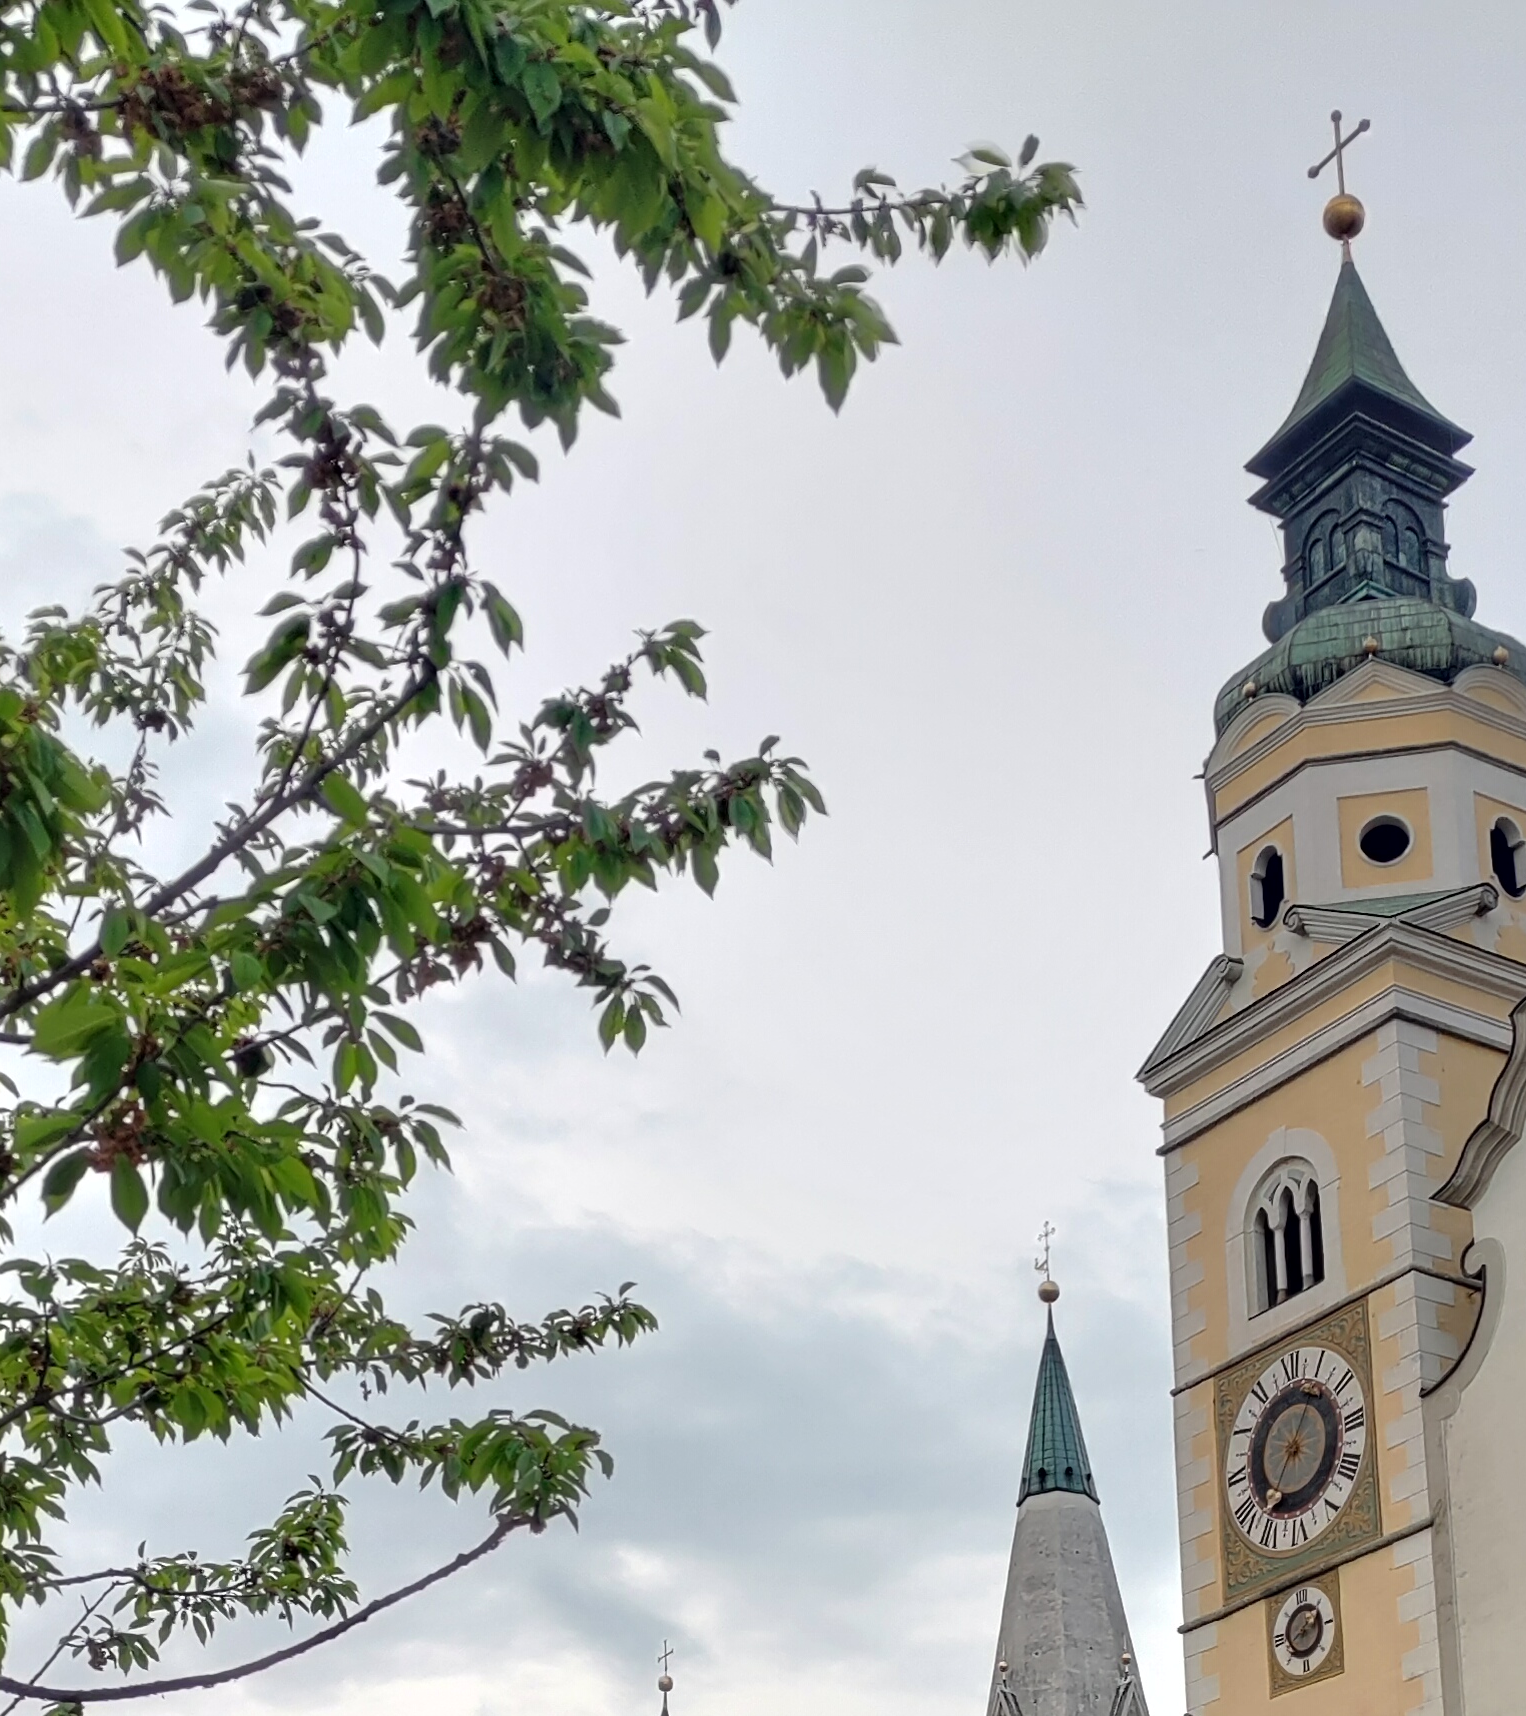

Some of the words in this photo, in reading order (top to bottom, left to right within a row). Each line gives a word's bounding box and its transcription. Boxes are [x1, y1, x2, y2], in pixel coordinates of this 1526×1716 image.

[1333, 1368, 1354, 1396] II
[1344, 1406, 1365, 1433] III
[1325, 1498, 1341, 1522] V
[1259, 1519, 1277, 1549] VII
[1291, 1519, 1309, 1547] VI
